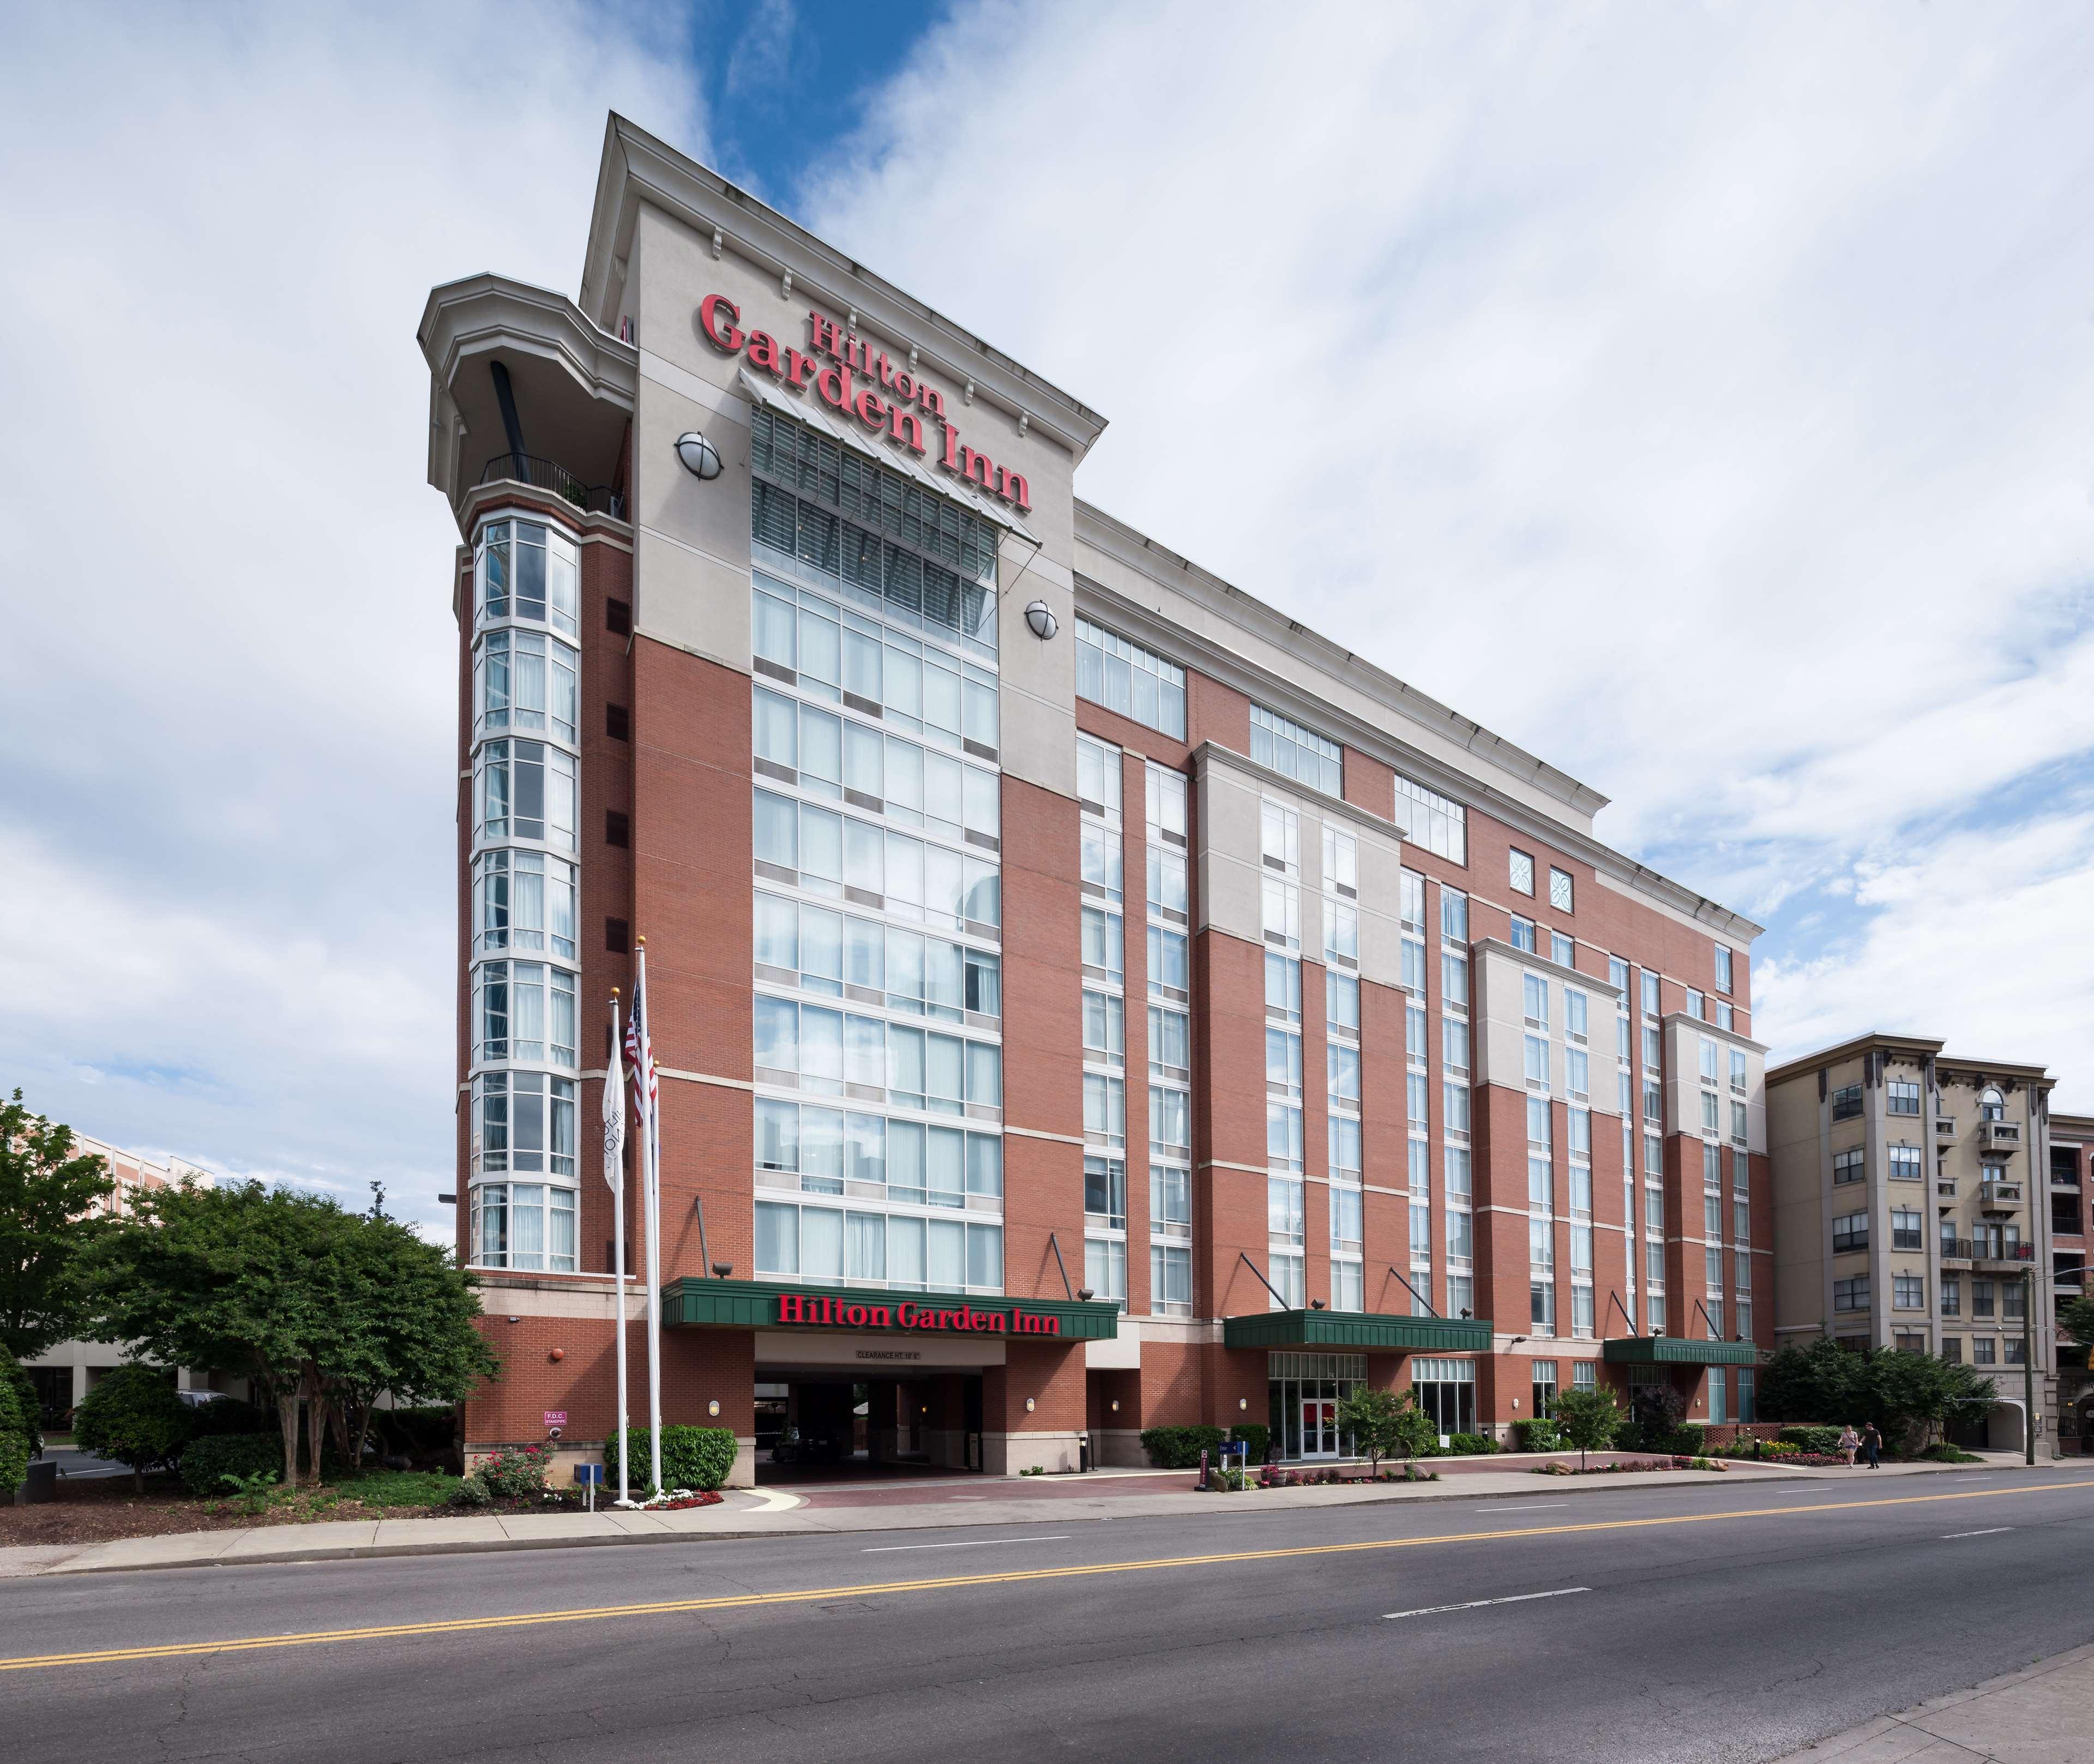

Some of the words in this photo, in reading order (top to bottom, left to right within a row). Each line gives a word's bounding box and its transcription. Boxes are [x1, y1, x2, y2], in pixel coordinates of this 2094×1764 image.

[700, 293, 926, 456] Garden
[937, 420, 1032, 514] Inn
[808, 310, 947, 422] Hilton
[777, 1294, 892, 1327] Hilton
[898, 1302, 1006, 1332] Garden
[1012, 1307, 1060, 1334] Inn
